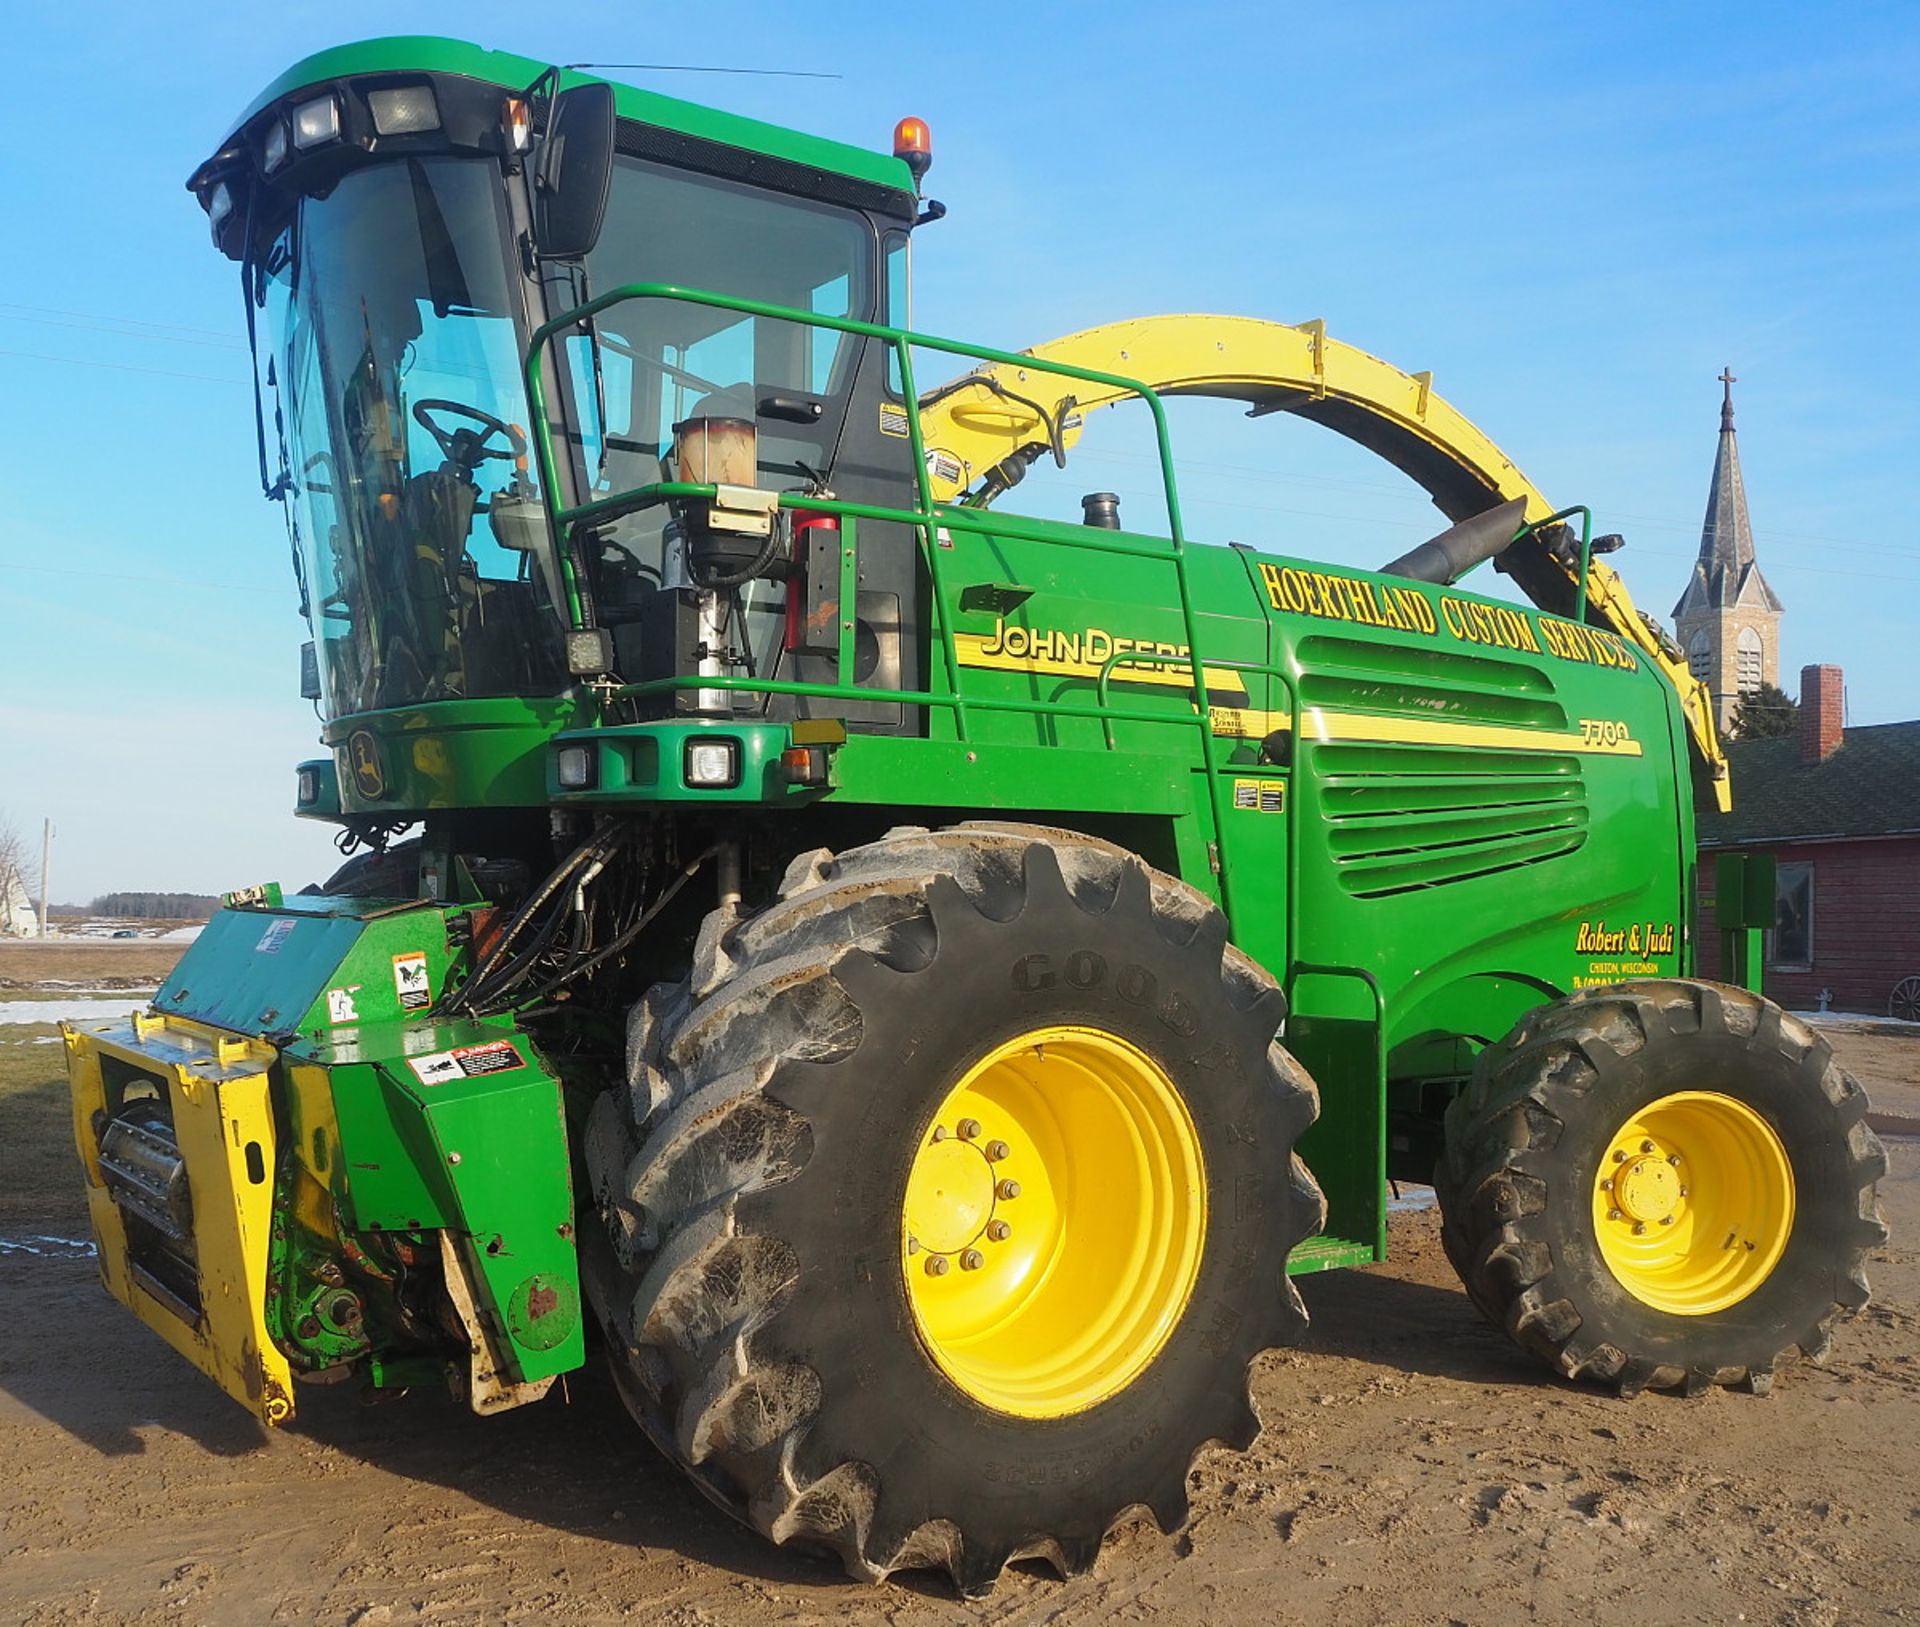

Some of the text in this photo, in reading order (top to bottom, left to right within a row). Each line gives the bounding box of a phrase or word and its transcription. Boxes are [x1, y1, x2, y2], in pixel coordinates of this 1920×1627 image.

[1257, 563, 1640, 674] HOERTHLAND CUSTOM SERVICES
[980, 617, 1083, 664] JOHN
[1578, 718, 1631, 746] 7700
[1575, 920, 1674, 960] Robert & Judi
[1621, 962, 1659, 974] WISCONSIN
